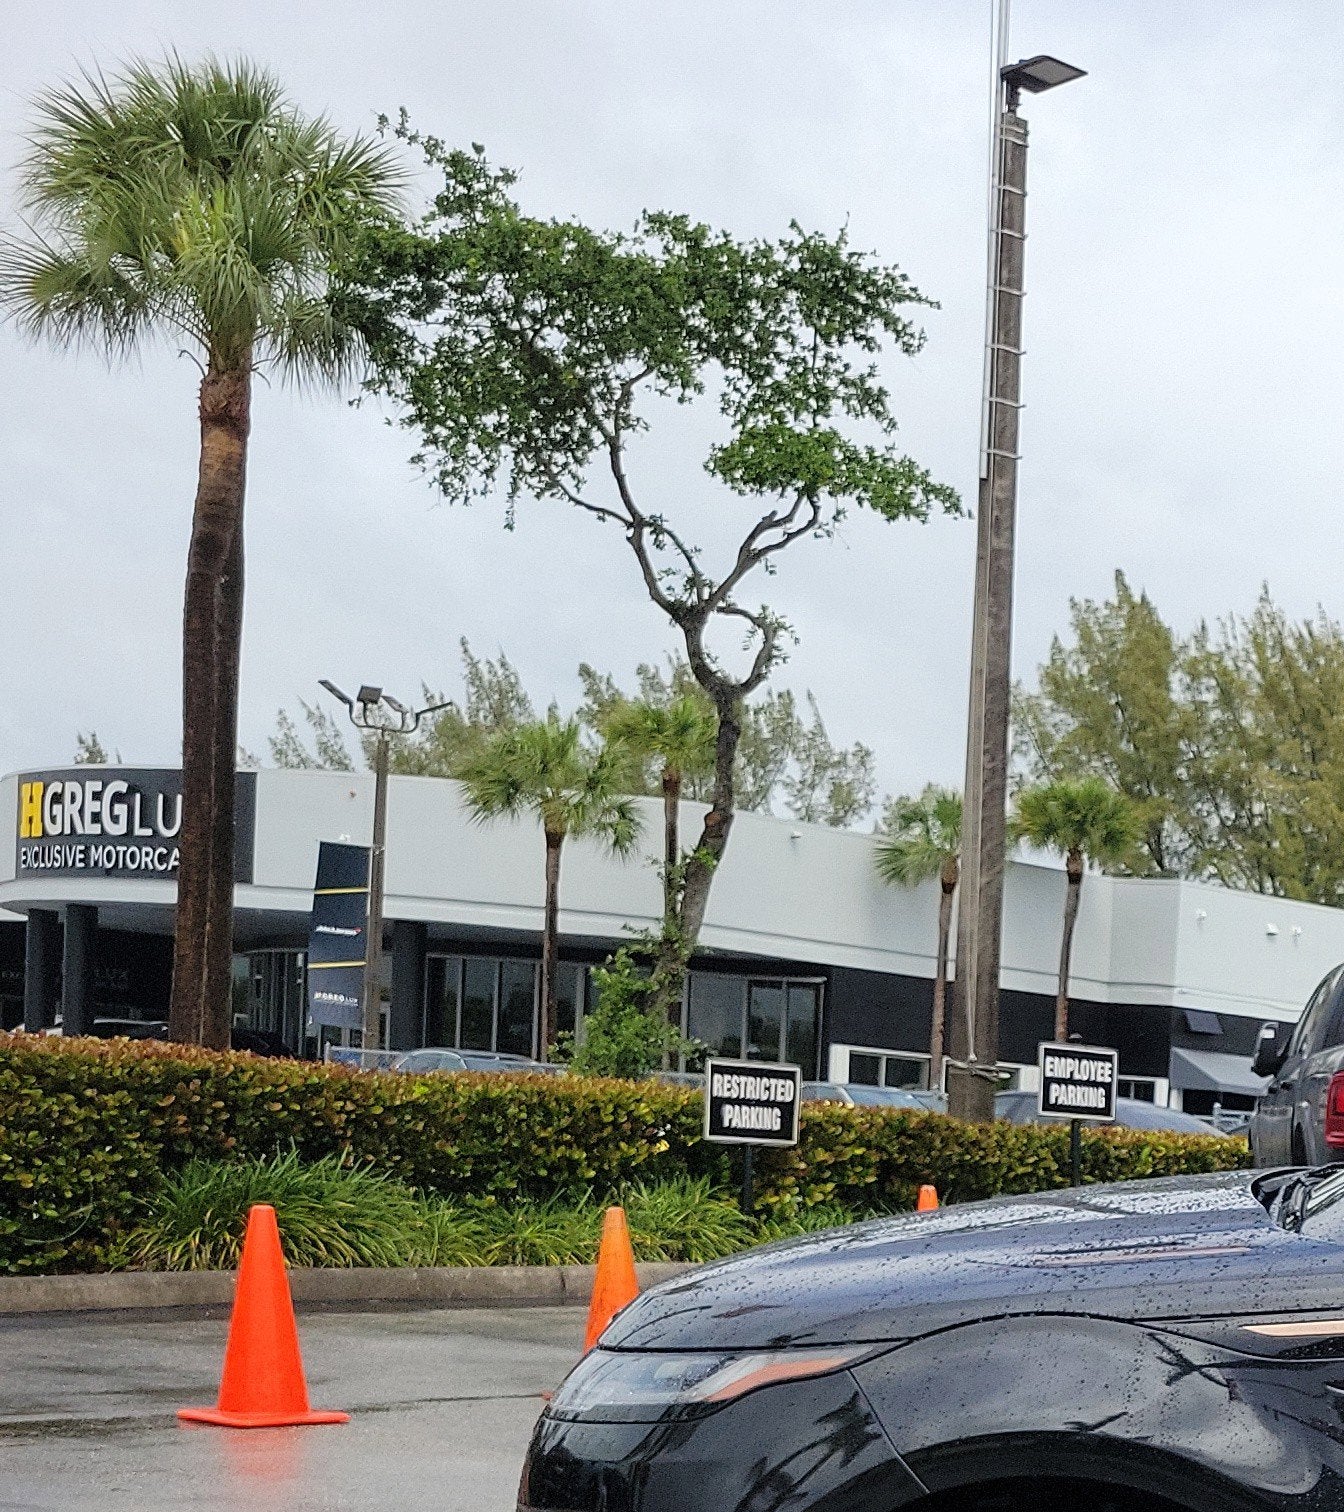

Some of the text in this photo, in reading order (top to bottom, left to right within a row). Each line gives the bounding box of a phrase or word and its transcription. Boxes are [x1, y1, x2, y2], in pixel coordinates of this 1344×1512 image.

[20, 780, 183, 838] HGREGLU
[20, 844, 180, 871] EXCLUSIVE MOTORCA
[1045, 1056, 1112, 1083] EMPLOYEE
[712, 1073, 794, 1102] RESTRICTED
[1049, 1082, 1105, 1108] PARKING
[722, 1104, 781, 1131] PARKING
